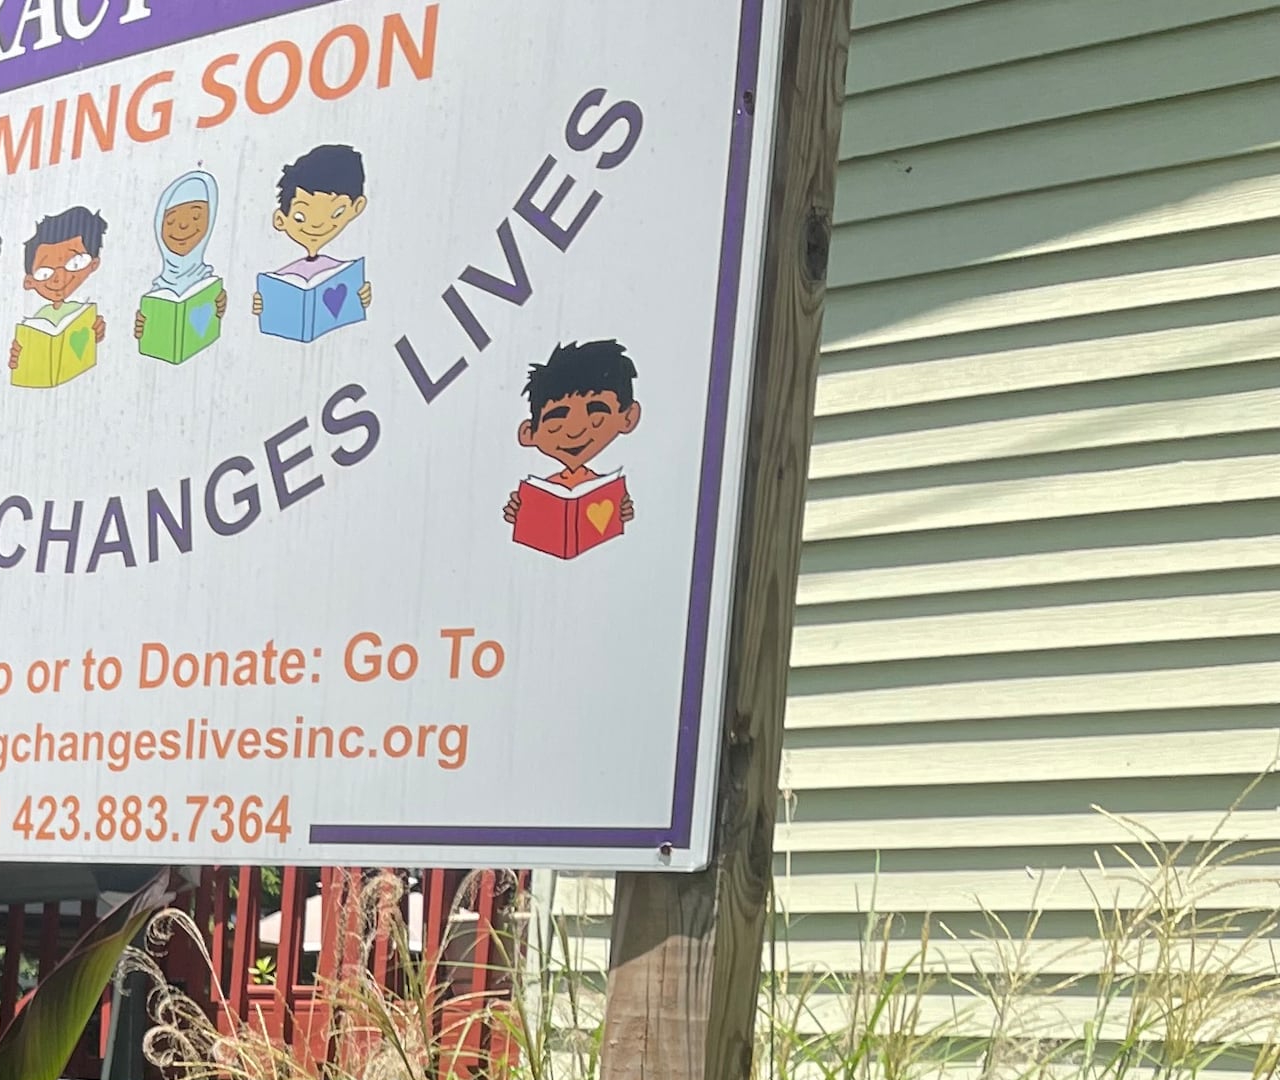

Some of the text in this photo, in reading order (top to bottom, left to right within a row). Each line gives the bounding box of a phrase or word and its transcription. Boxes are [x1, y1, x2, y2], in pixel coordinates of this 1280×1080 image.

[195, 3, 439, 130] SOON
[394, 87, 644, 405] LIVES
[26, 658, 70, 694] or
[82, 648, 123, 692] to
[139, 639, 322, 689] Donate:
[343, 631, 419, 683] Go
[440, 627, 505, 679] To
[12, 794, 292, 844] 423.883.7364
